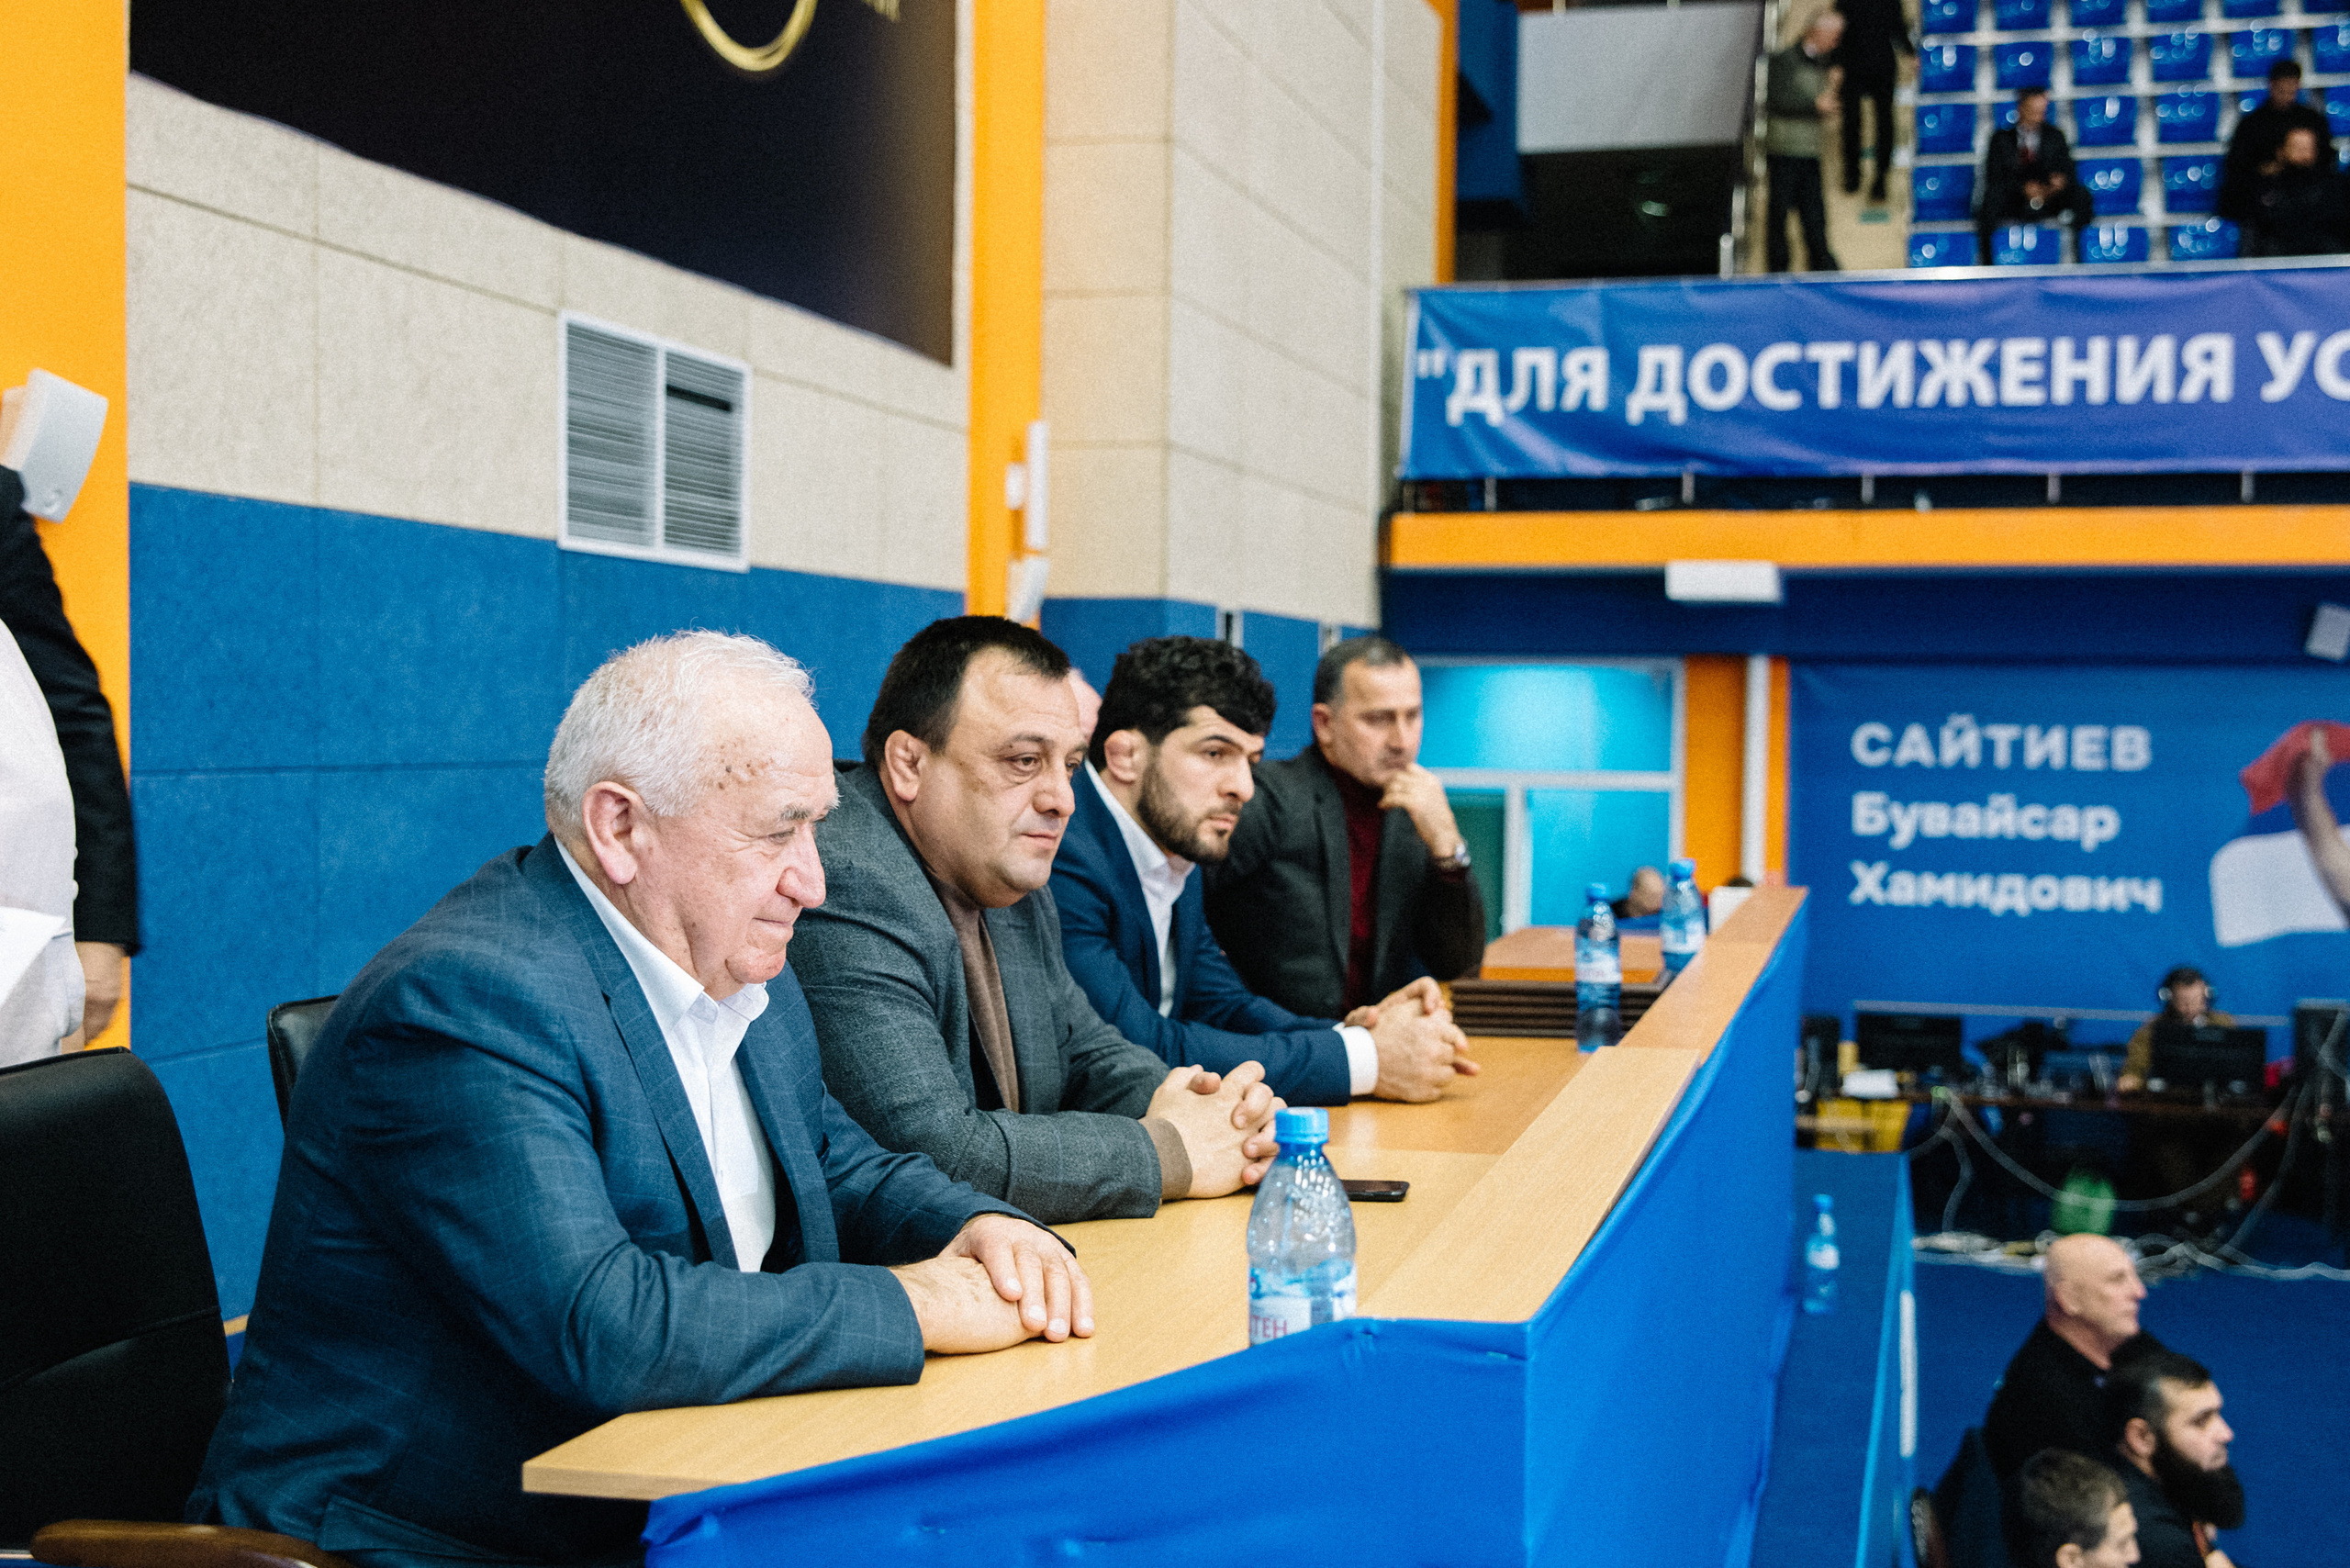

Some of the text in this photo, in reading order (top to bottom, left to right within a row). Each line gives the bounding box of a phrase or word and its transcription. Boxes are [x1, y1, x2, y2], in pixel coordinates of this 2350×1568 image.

[1416, 346, 1610, 427] "ДЛЯ
[1625, 331, 2234, 426] ДОСТИЖЕНИЯ
[1851, 713, 2152, 771] САЙТИЕВ
[1851, 791, 2121, 851] Бувайсар
[1849, 860, 2163, 916] Хамидович
